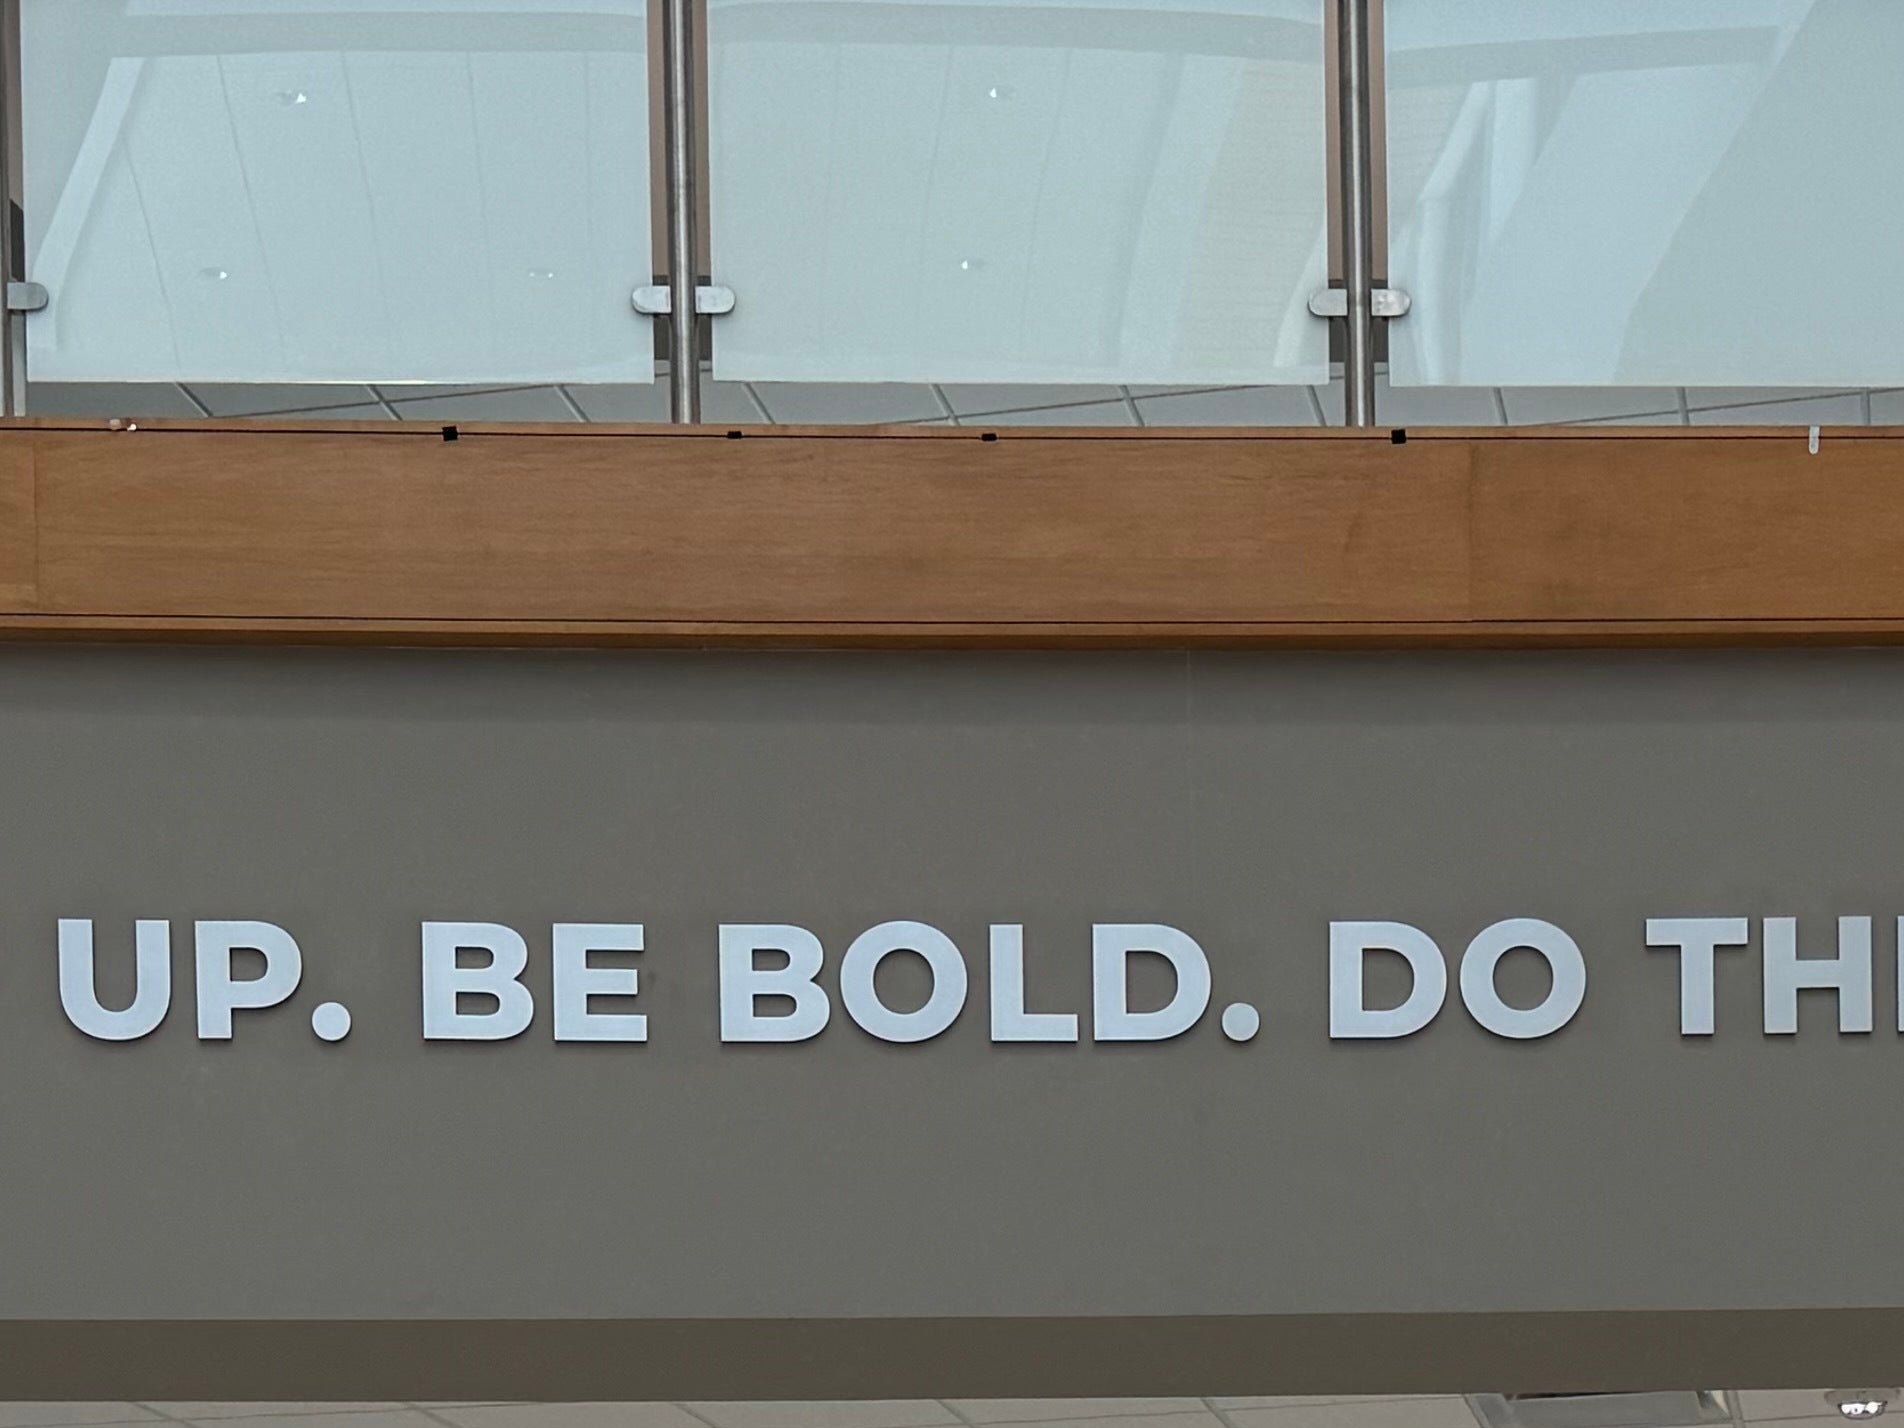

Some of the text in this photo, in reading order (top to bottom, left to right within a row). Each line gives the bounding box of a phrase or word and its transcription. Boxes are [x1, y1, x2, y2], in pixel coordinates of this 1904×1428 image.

[57, 918, 352, 1042] UP.
[421, 921, 649, 1043] BE
[718, 920, 1261, 1043] BOLD.
[1329, 918, 1587, 1040] DO
